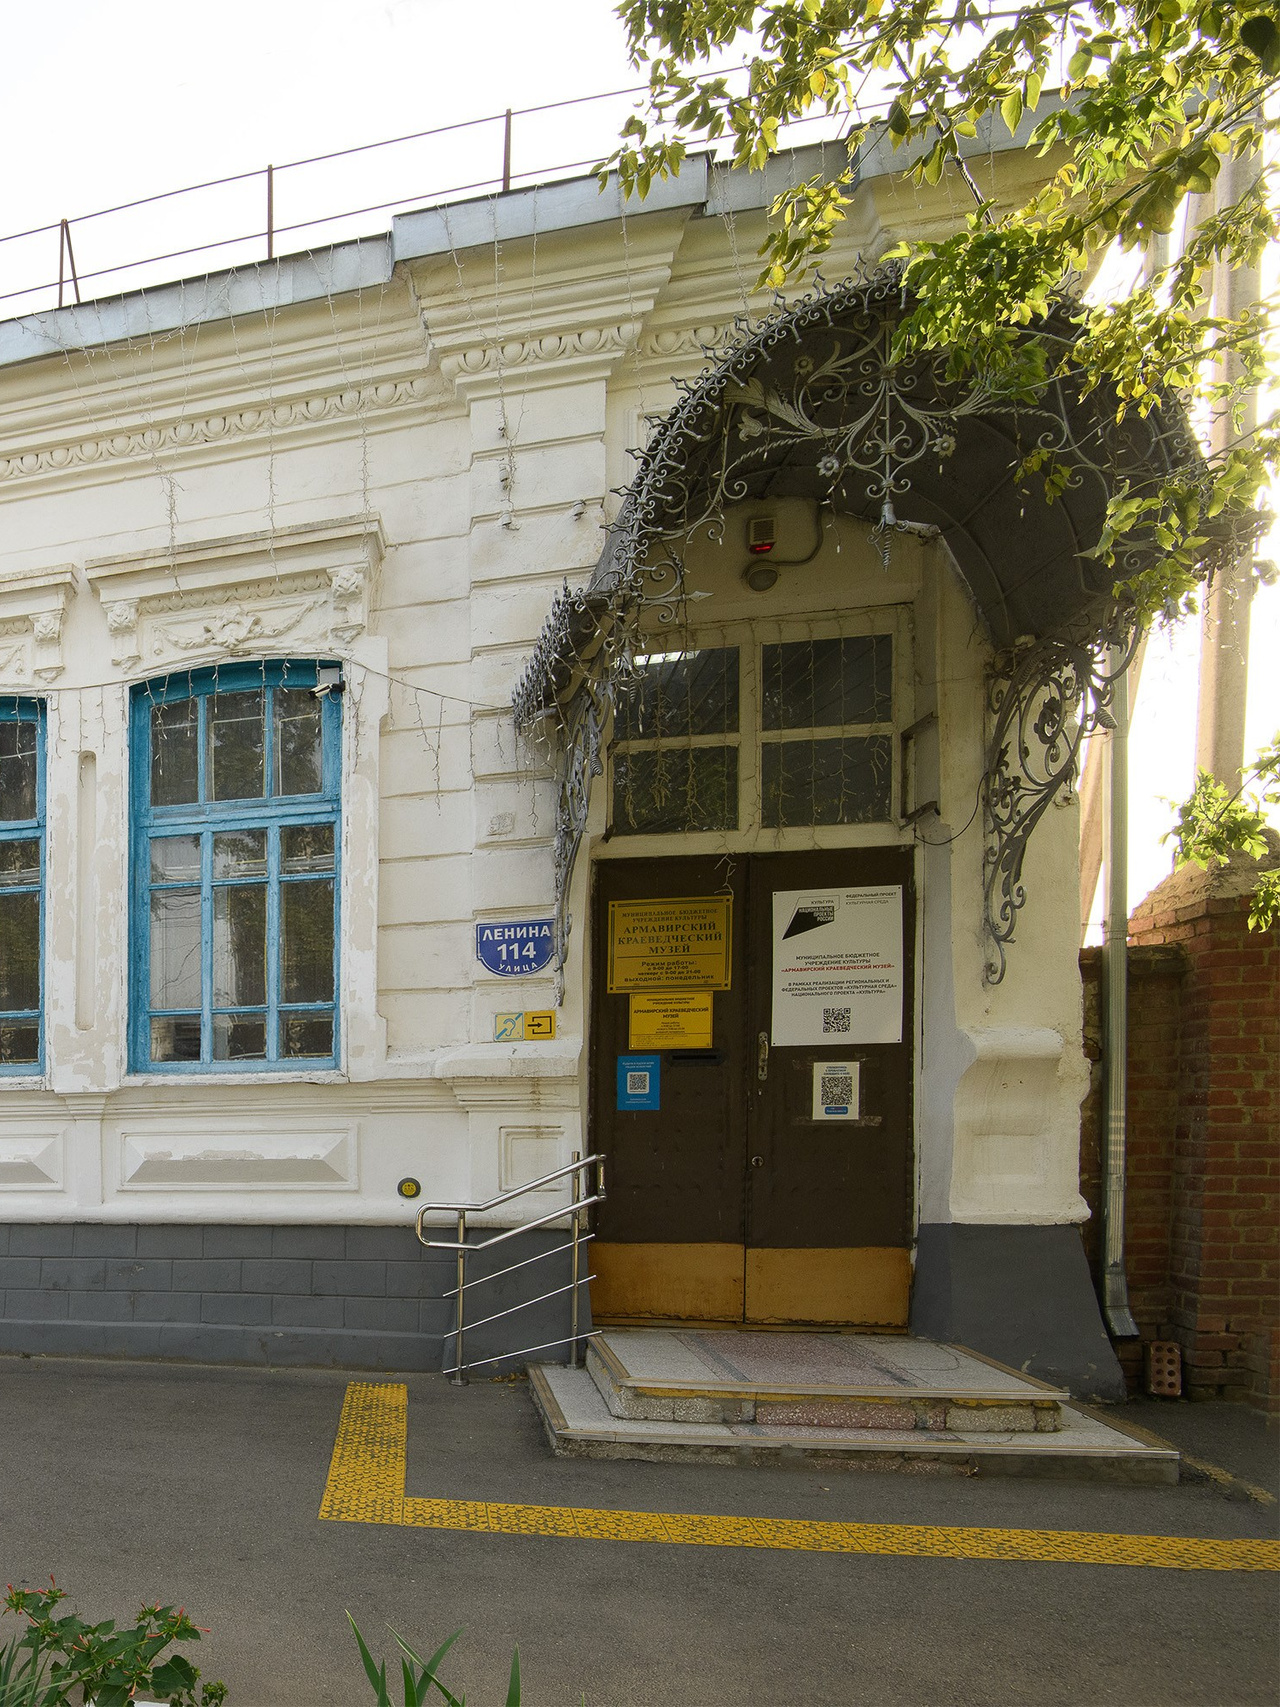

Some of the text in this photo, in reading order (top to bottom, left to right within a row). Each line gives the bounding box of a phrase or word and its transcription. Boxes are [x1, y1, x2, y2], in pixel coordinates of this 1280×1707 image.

[483, 925, 550, 941] ЛЕНИНА
[624, 921, 716, 934] АРМАВИРСКИЙ
[618, 932, 722, 945] КРАЕВЕДЧЕСКИЙ
[497, 942, 536, 960] 114
[649, 944, 690, 954] МУЗЕЙ
[499, 962, 538, 972] УЛИЦА
